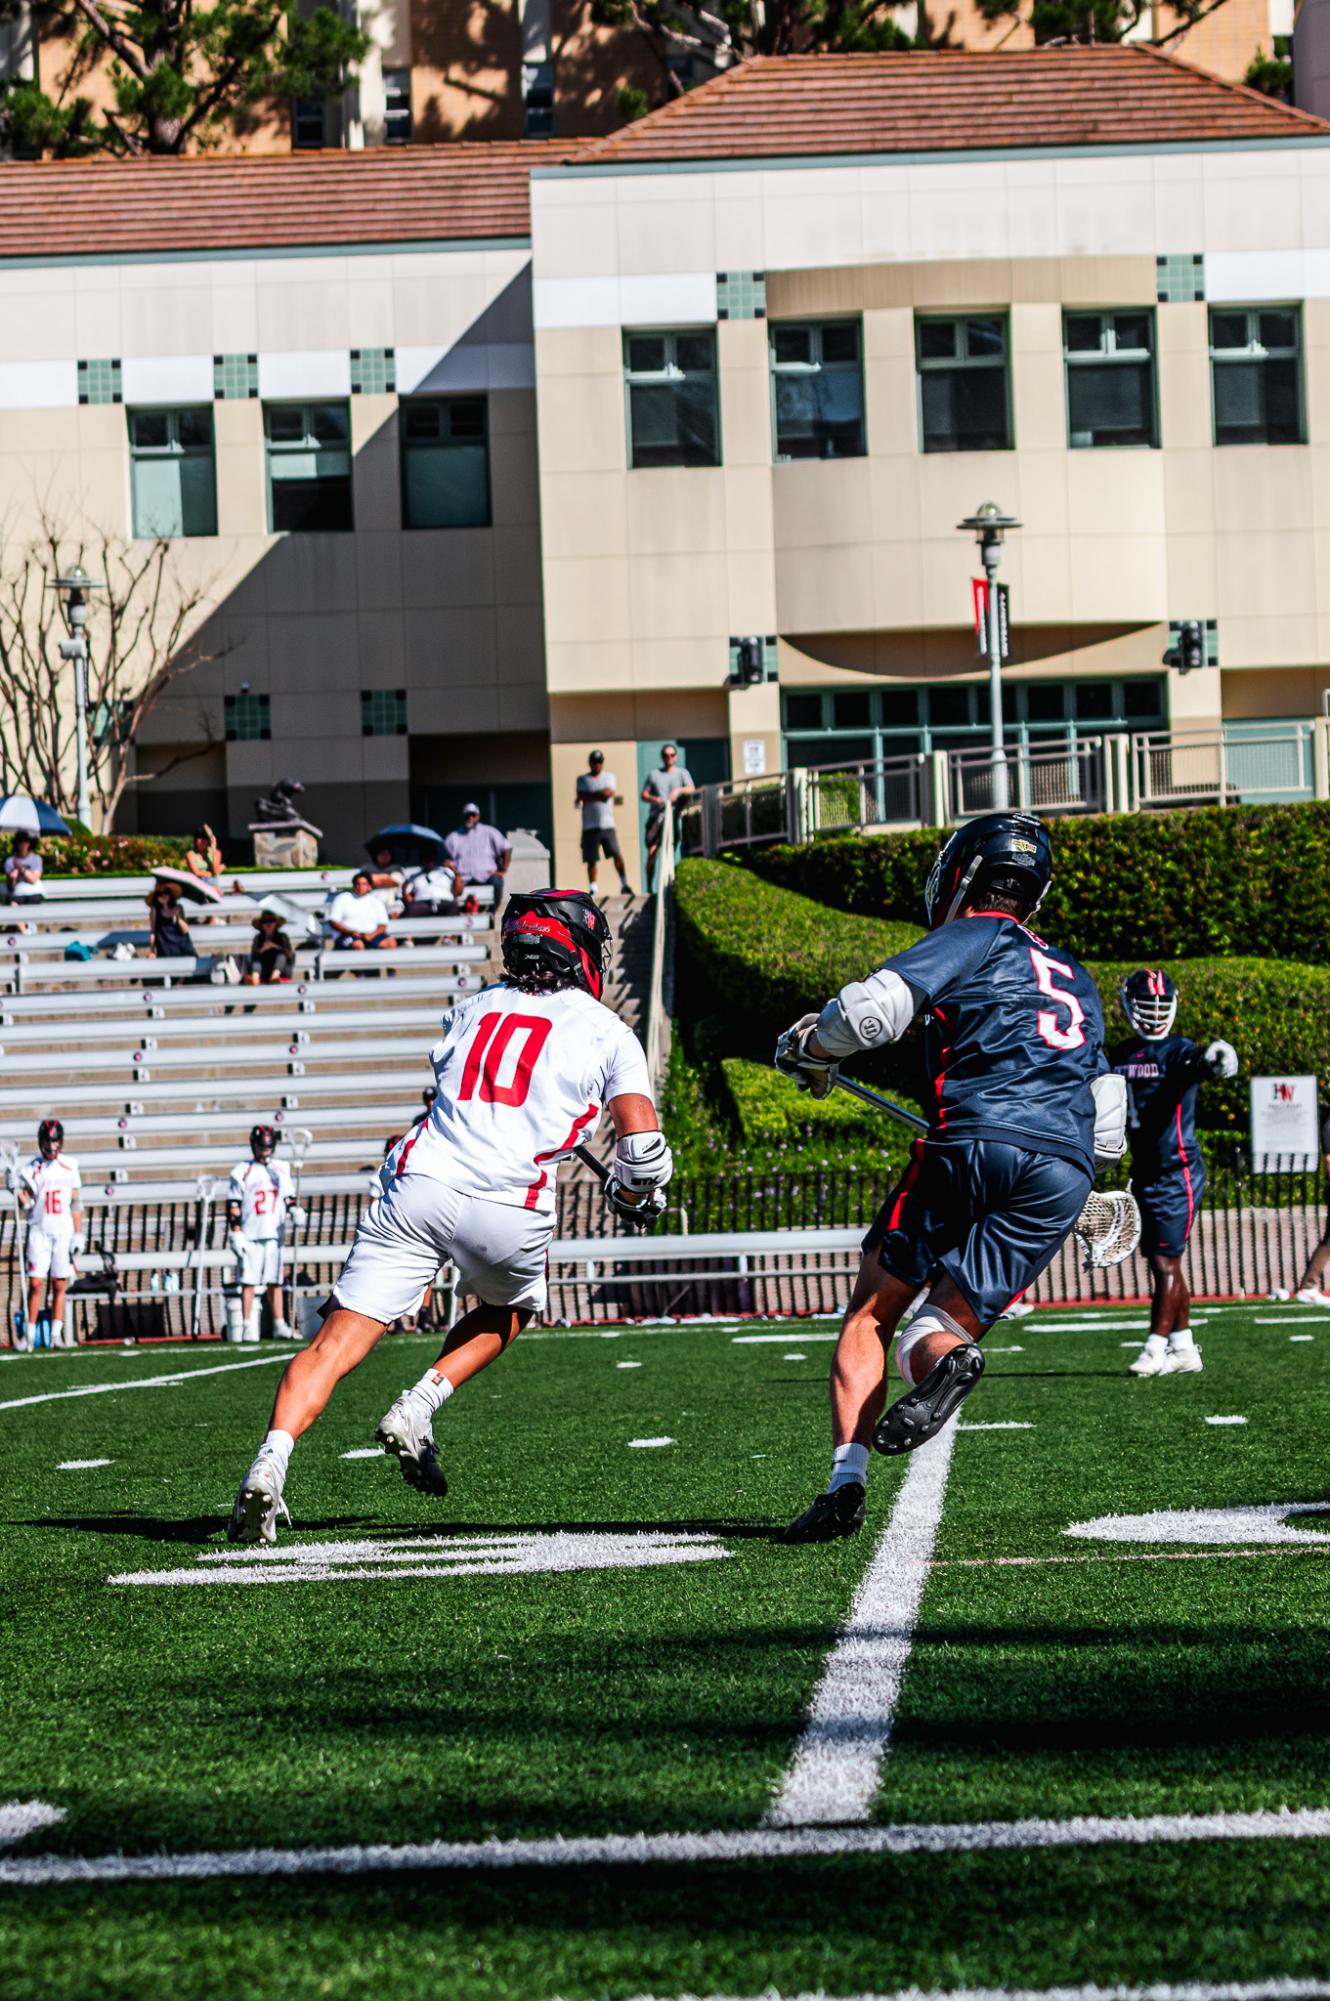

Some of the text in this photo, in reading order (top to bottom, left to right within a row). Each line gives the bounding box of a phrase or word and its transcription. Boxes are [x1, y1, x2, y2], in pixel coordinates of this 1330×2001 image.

[1029, 946, 1087, 1050] 5
[457, 1012, 553, 1107] 10
[45, 1190, 61, 1214] 16
[254, 1188, 279, 1216] 27
